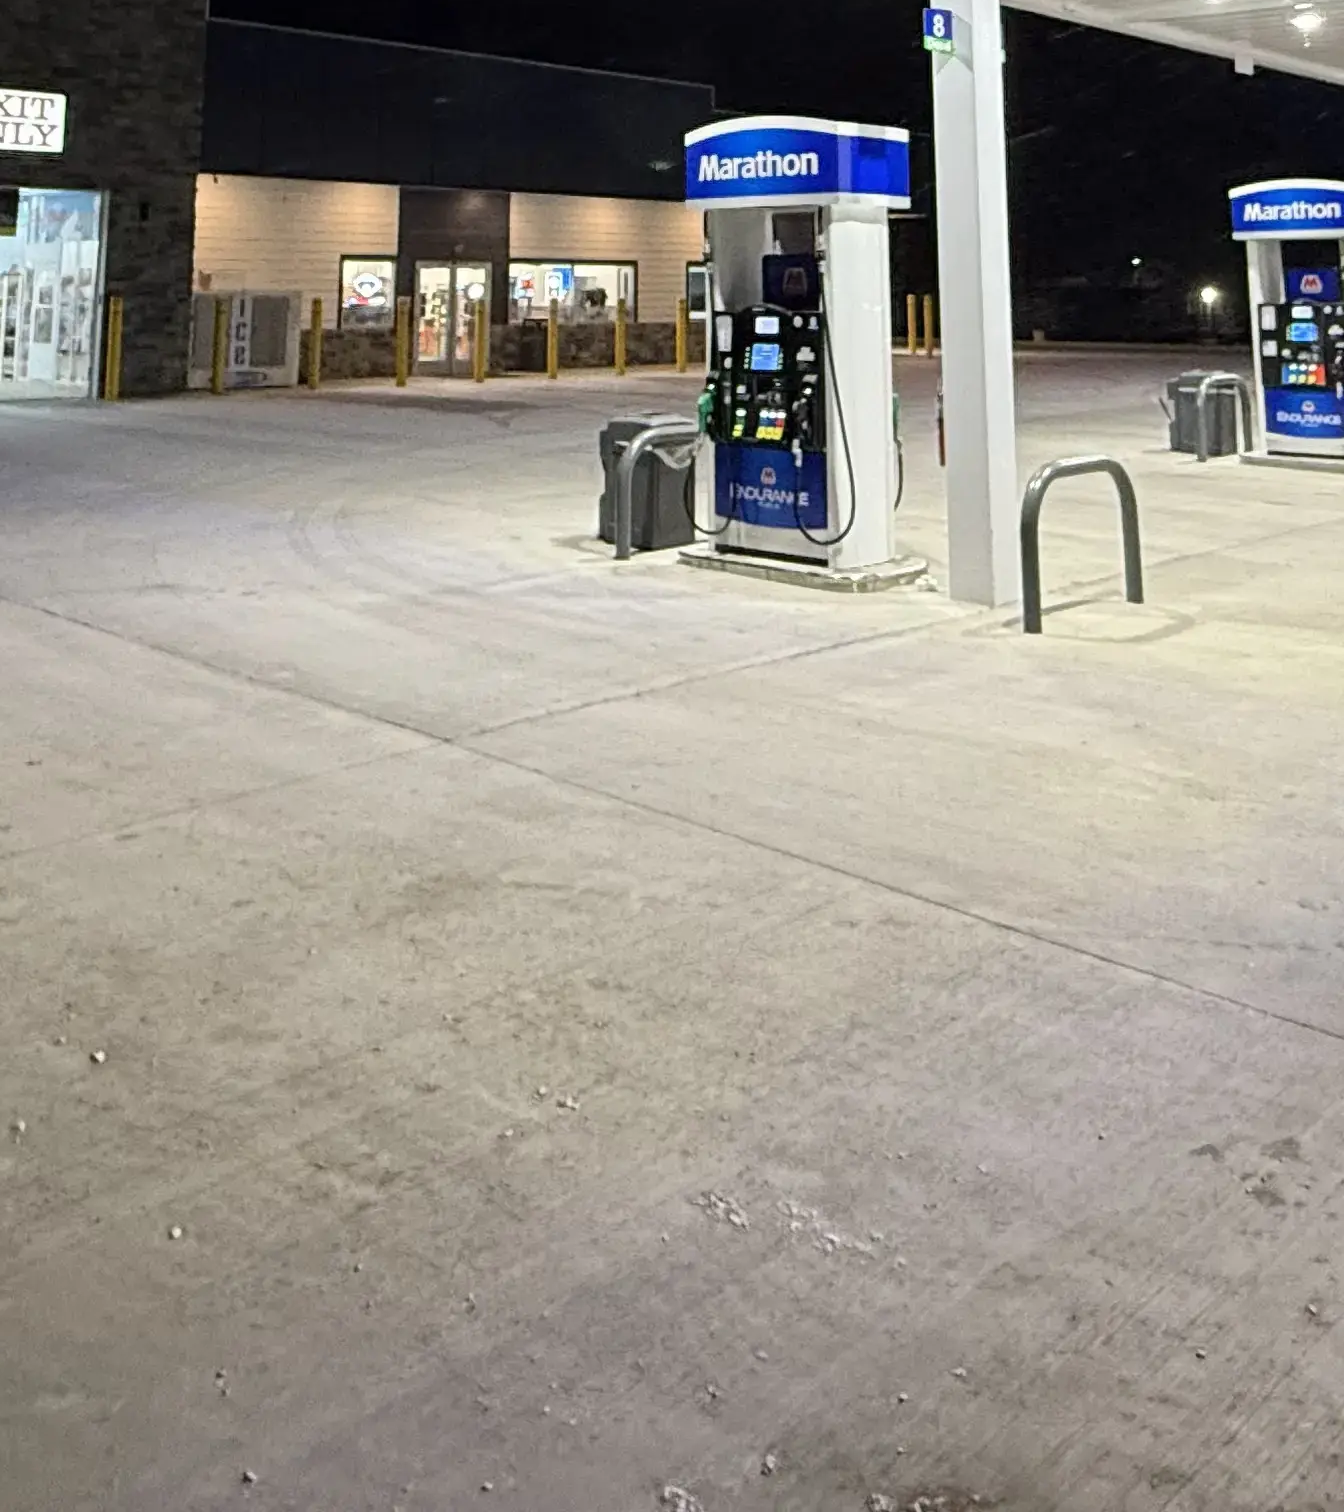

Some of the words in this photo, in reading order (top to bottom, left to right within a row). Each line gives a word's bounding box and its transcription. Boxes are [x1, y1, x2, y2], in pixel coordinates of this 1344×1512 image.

[932, 13, 946, 38] 8
[697, 149, 820, 182] Marathon
[1242, 200, 1342, 222] Marathon
[233, 298, 248, 365] ICE
[729, 482, 810, 507] NDURANE
